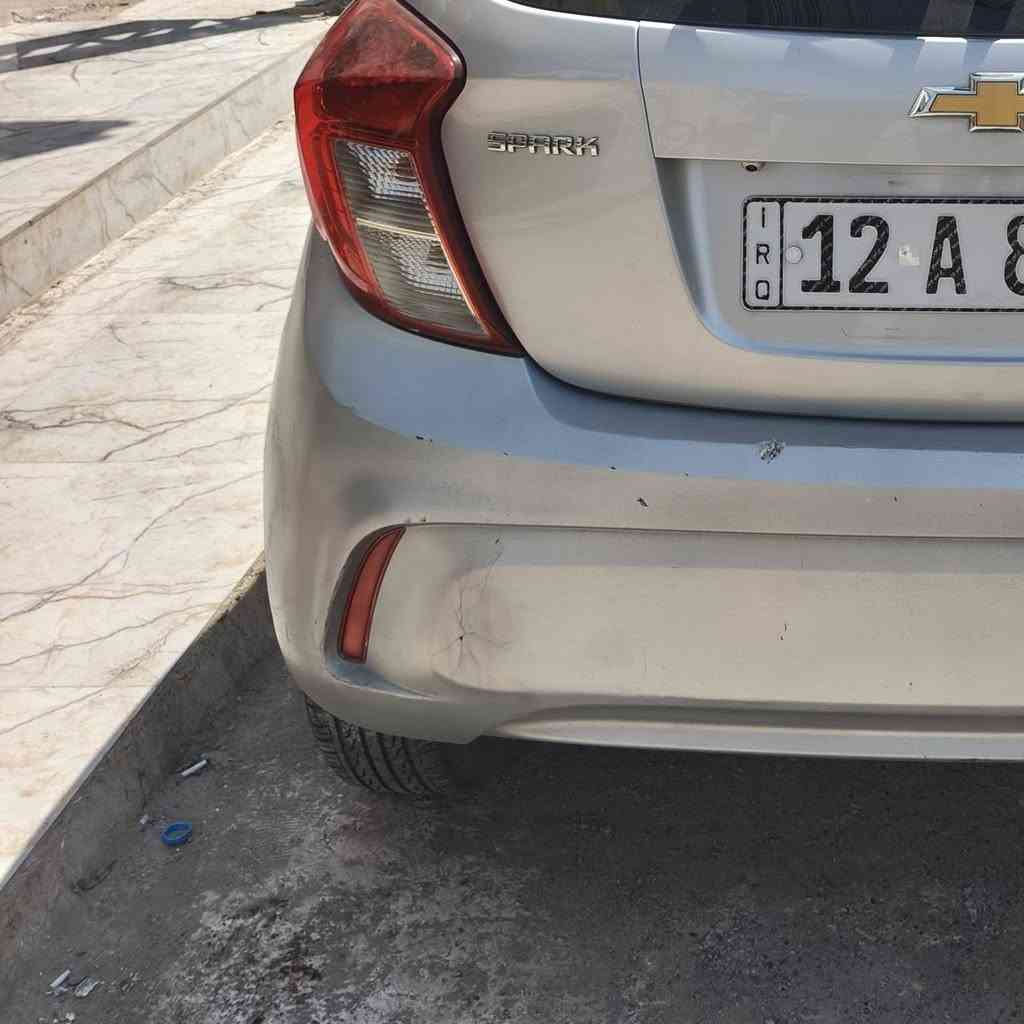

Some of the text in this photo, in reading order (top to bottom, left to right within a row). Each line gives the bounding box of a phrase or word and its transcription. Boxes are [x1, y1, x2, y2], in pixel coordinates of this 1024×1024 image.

[487, 130, 600, 157] SPARK
[800, 213, 890, 295] 12
[925, 215, 968, 295] A
